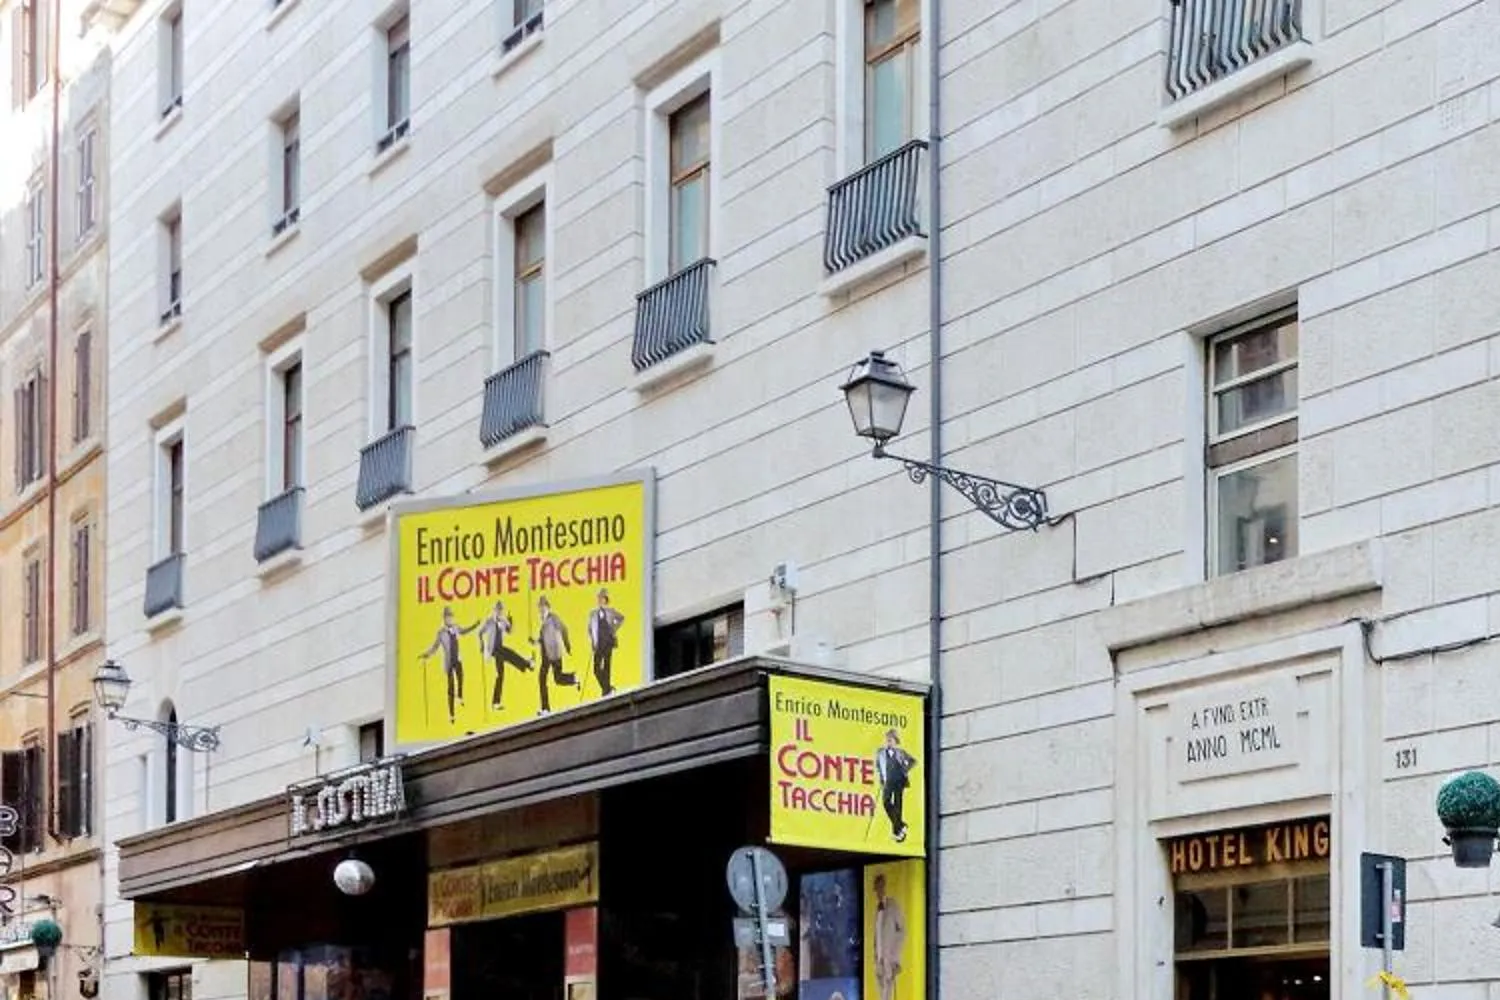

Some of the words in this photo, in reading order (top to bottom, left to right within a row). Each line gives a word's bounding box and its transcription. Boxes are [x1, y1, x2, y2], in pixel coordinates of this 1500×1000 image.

[416, 524, 485, 567] Enrico
[493, 513, 625, 558] Montesano
[418, 575, 434, 604] IL
[437, 565, 520, 601] CONTE
[526, 551, 626, 592] TACCHIA
[775, 691, 822, 717] Enrico
[827, 699, 908, 729] Montesano
[1191, 711, 1200, 730] A
[795, 718, 814, 742] IL
[1187, 734, 1227, 763] ANNO
[1240, 723, 1281, 753] MCML
[777, 744, 875, 785] CONTE
[1395, 749, 1418, 769] 131
[777, 780, 876, 817] TACCHIA
[1172, 833, 1253, 873] HOTEL
[1266, 821, 1329, 863] KING
